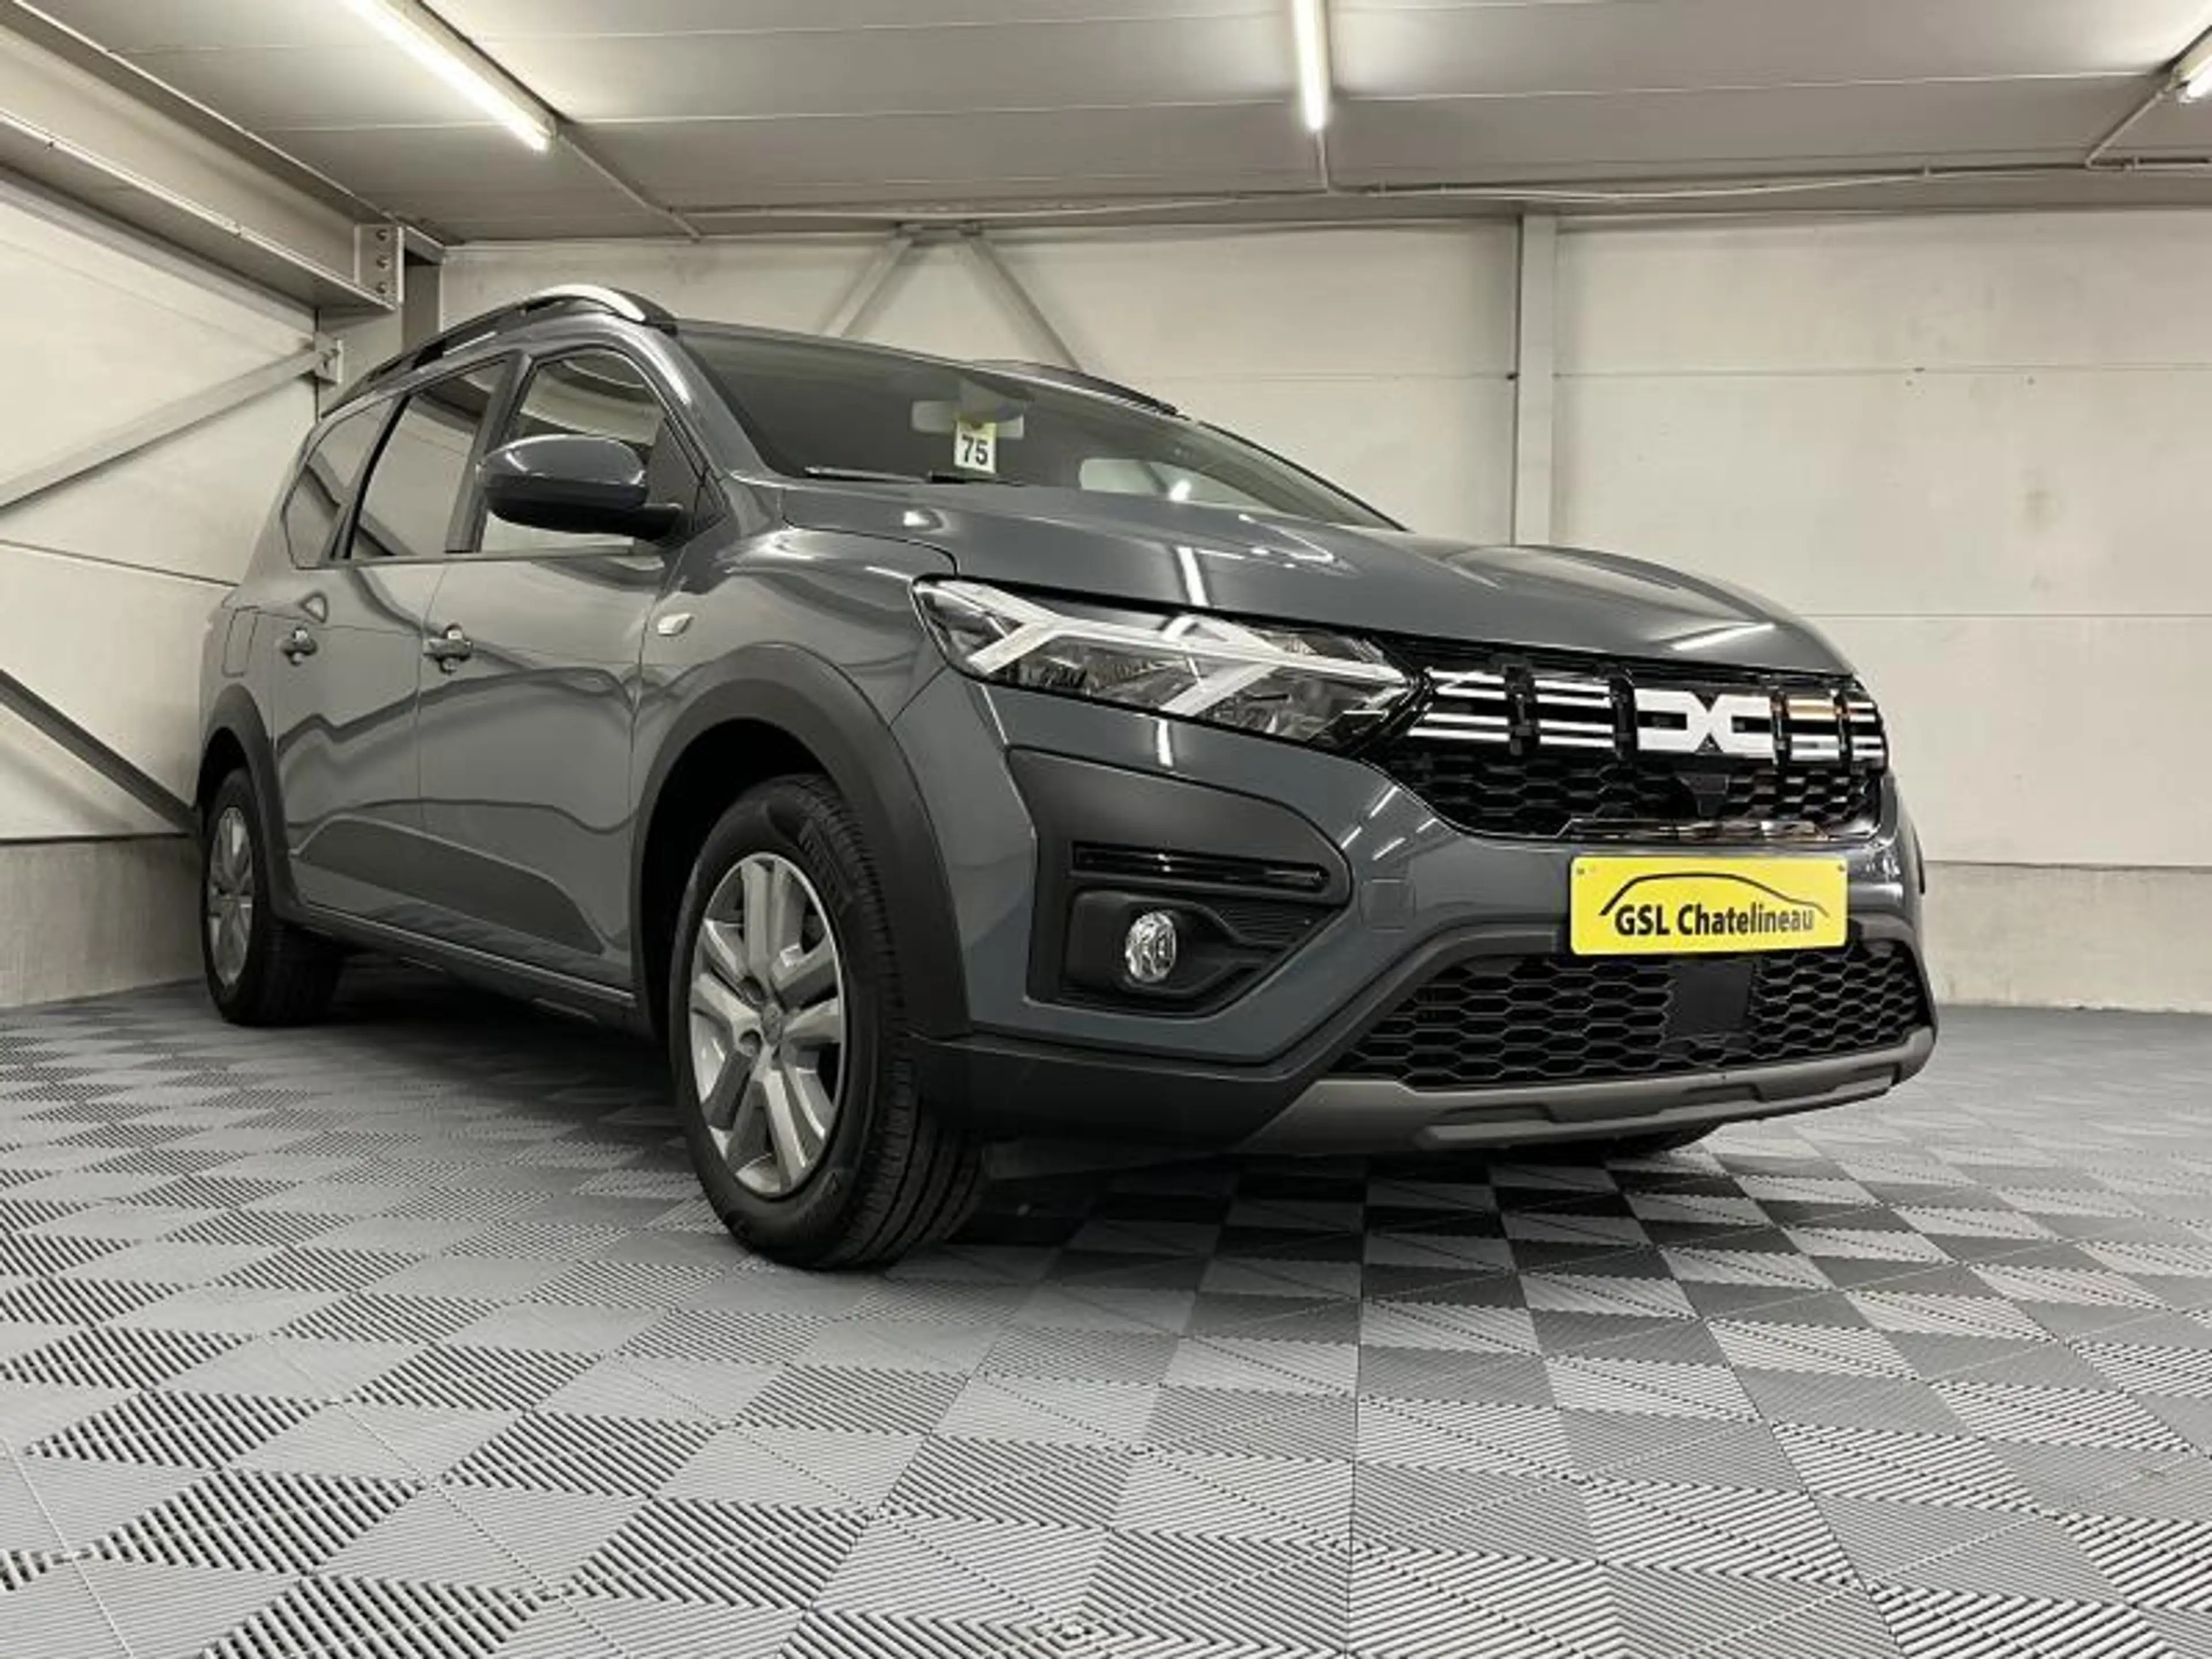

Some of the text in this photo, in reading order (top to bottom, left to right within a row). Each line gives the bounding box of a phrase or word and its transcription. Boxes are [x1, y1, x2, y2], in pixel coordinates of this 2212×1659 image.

[961, 434, 988, 465] 75
[1616, 902, 1815, 935] GSL Chatelineau
